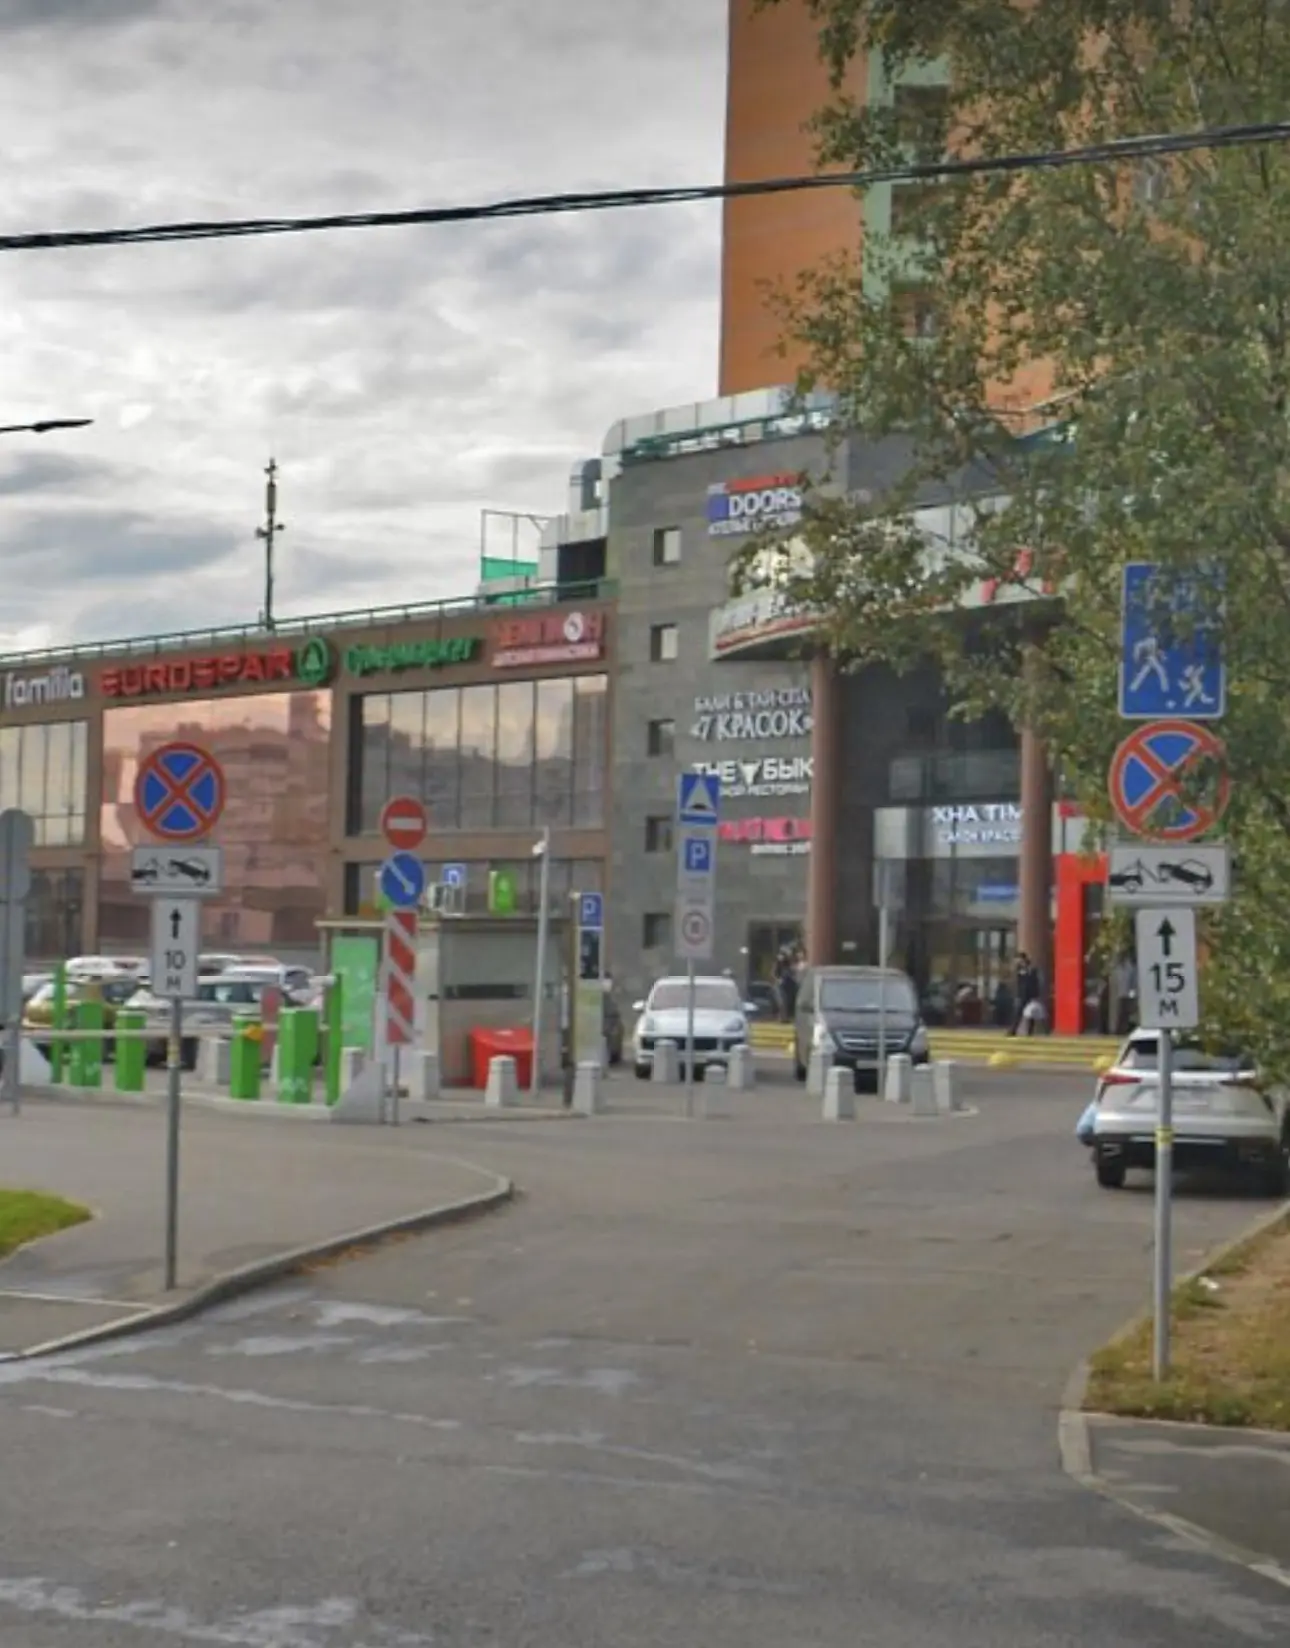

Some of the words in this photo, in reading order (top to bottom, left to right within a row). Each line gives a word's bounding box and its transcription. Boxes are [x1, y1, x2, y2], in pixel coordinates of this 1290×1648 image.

[729, 487, 801, 518] DOORS
[5, 666, 84, 709] familia
[101, 646, 292, 697] EUROSPAR
[164, 949, 186, 970] 10
[1149, 962, 1185, 994] 15
